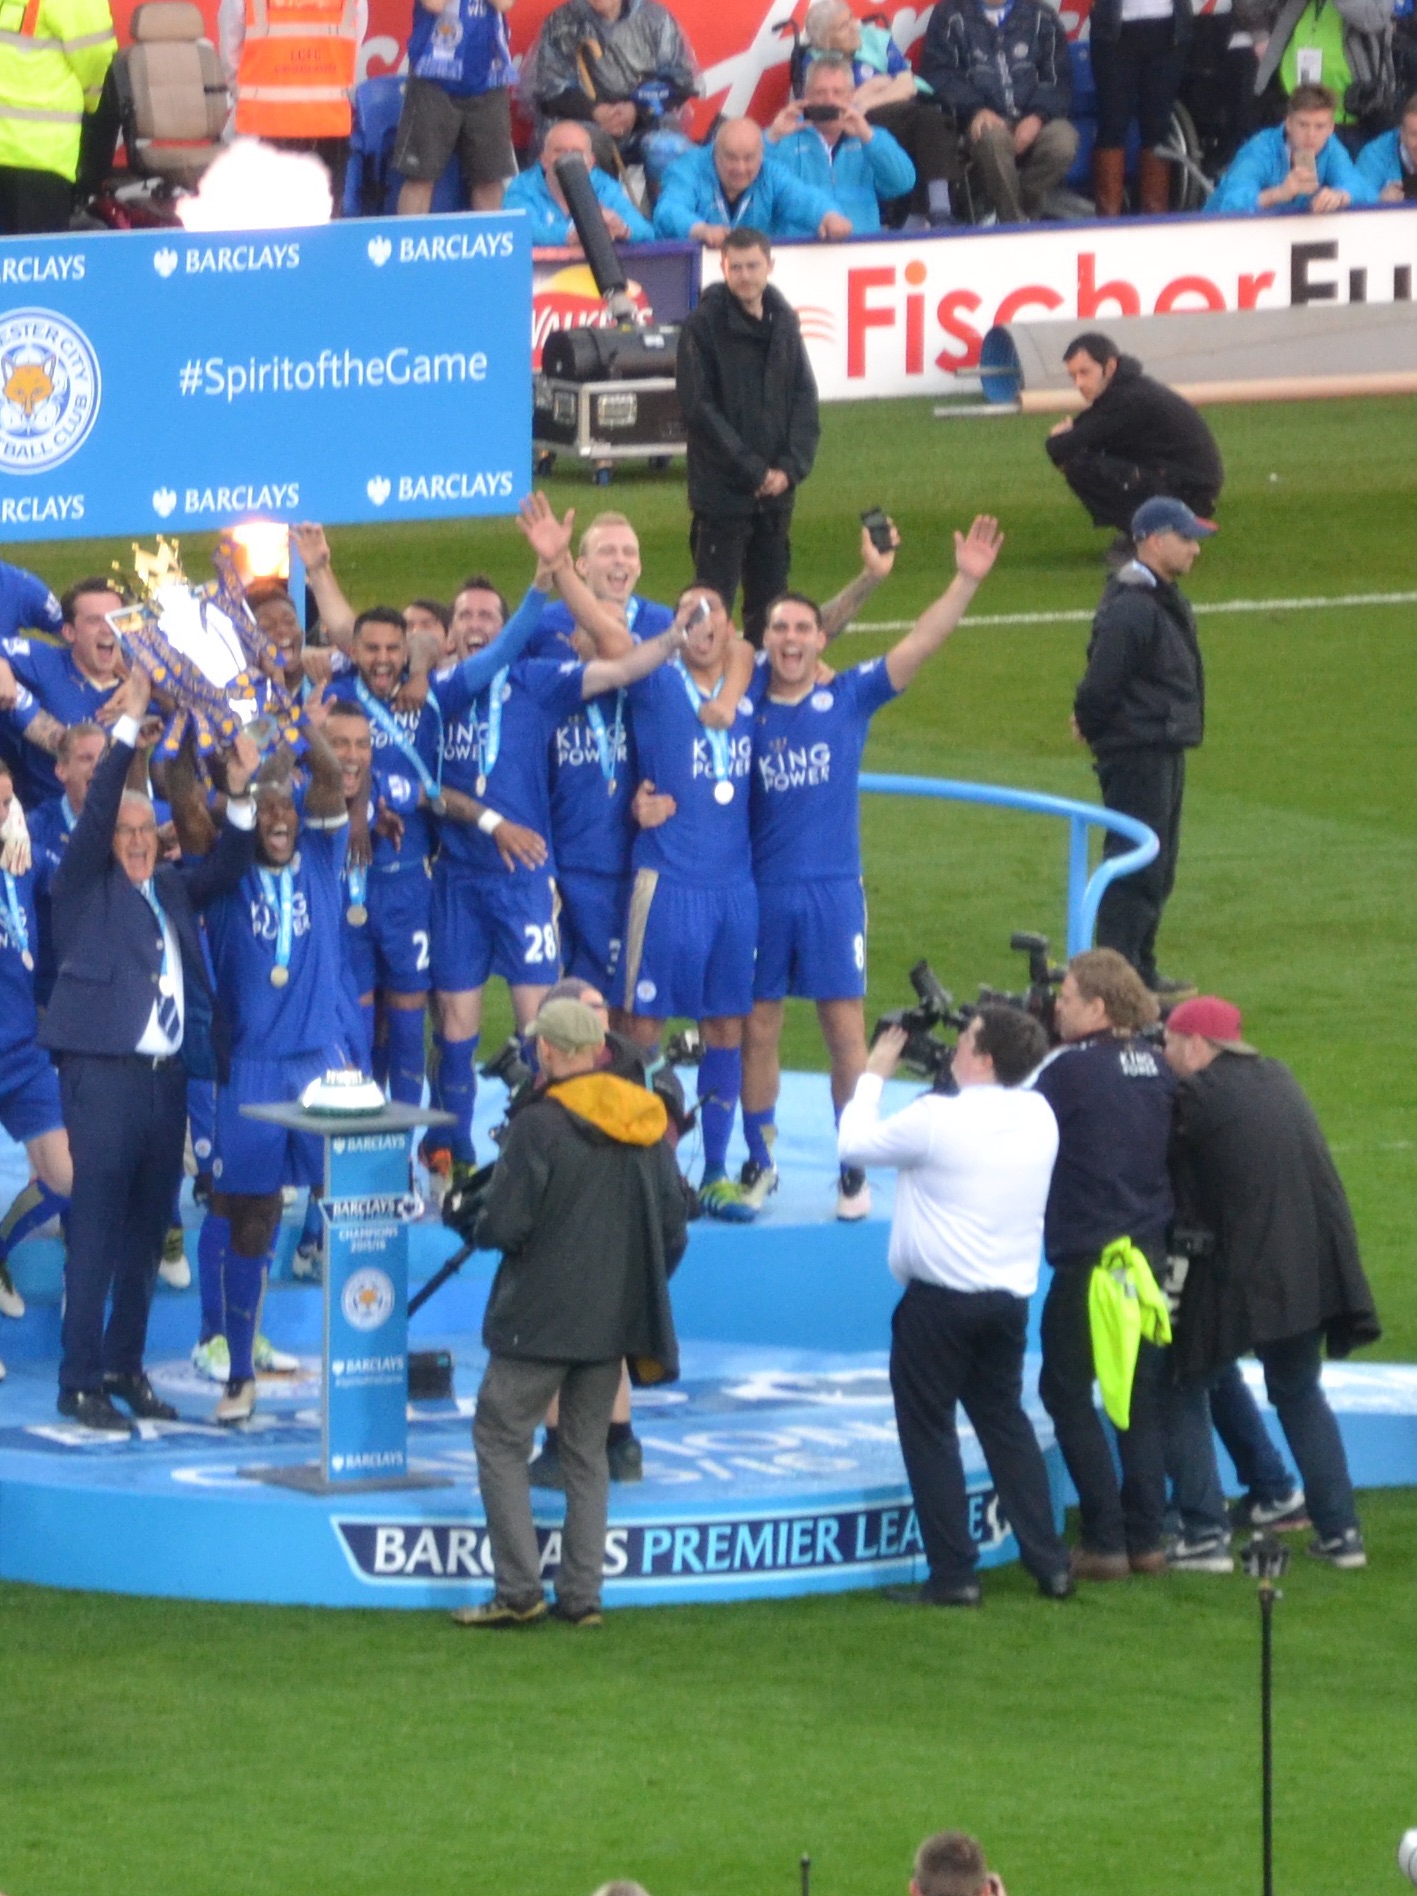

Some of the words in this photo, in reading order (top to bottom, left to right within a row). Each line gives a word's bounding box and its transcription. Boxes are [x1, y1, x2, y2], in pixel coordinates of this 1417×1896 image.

[185, 243, 300, 273] BARCLAYS
[399, 231, 514, 263] BARCLAYS
[59, 337, 89, 383] CITY
[179, 347, 488, 403] #SpiritoftheGame
[53, 393, 88, 446] CLUB
[184, 483, 300, 513] BARCLAYS
[397, 471, 513, 502] BARCLAYS
[558, 745, 628, 767] POWR
[693, 735, 752, 761] KNG
[759, 742, 831, 777] KING
[693, 757, 751, 779] POER
[763, 764, 830, 792] POWER
[411, 930, 431, 972] 2
[523, 923, 558, 964] 28
[853, 932, 865, 972] 8
[346, 1135, 405, 1153] BARCLAYS
[333, 1199, 395, 1218] BARCLAYS
[374, 1527, 629, 1577] BARAS
[641, 1518, 845, 1575] PREMIER
[855, 1496, 983, 1560] LEAE
